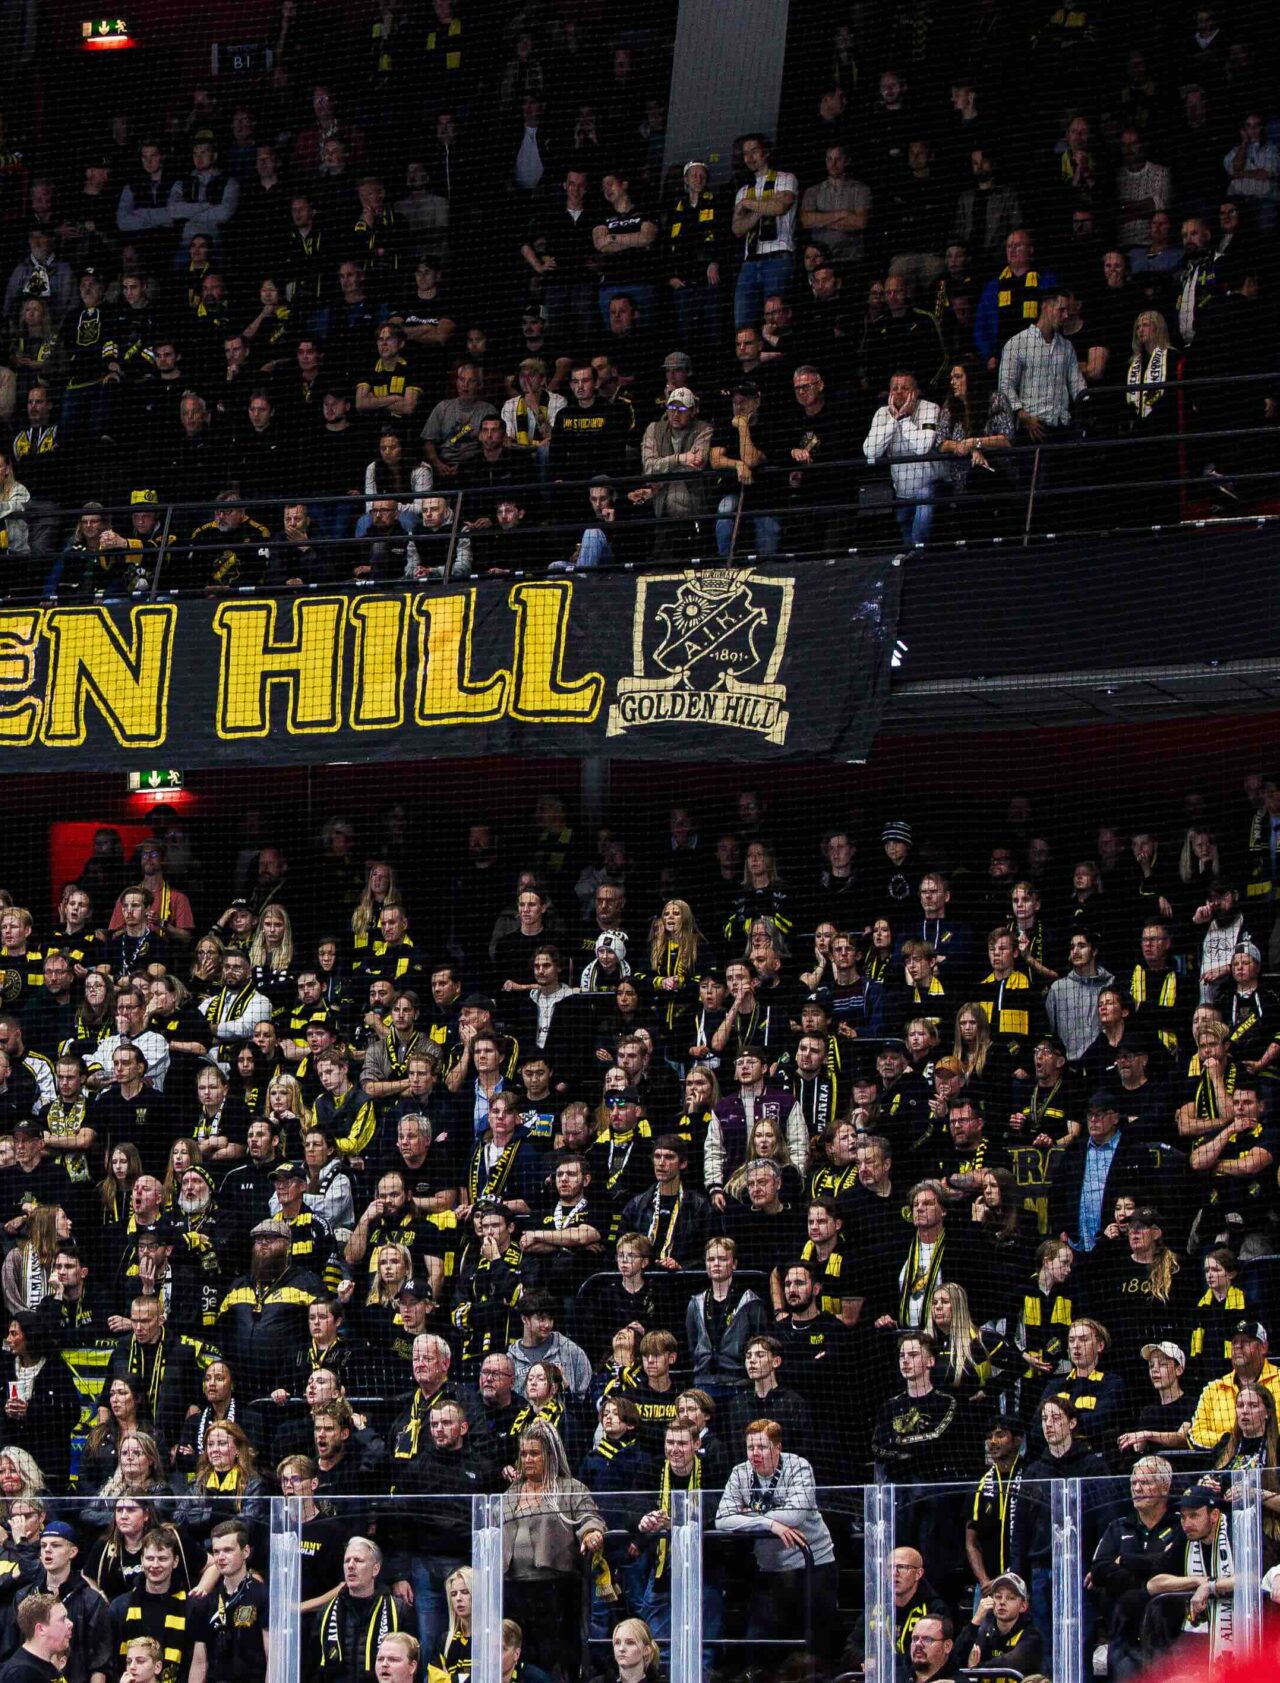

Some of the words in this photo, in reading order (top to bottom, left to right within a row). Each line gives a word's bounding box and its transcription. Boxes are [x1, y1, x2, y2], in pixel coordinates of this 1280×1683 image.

[215, 580, 606, 740] HILL
[621, 692, 716, 724] GOLDEN
[722, 698, 778, 730] HILL
